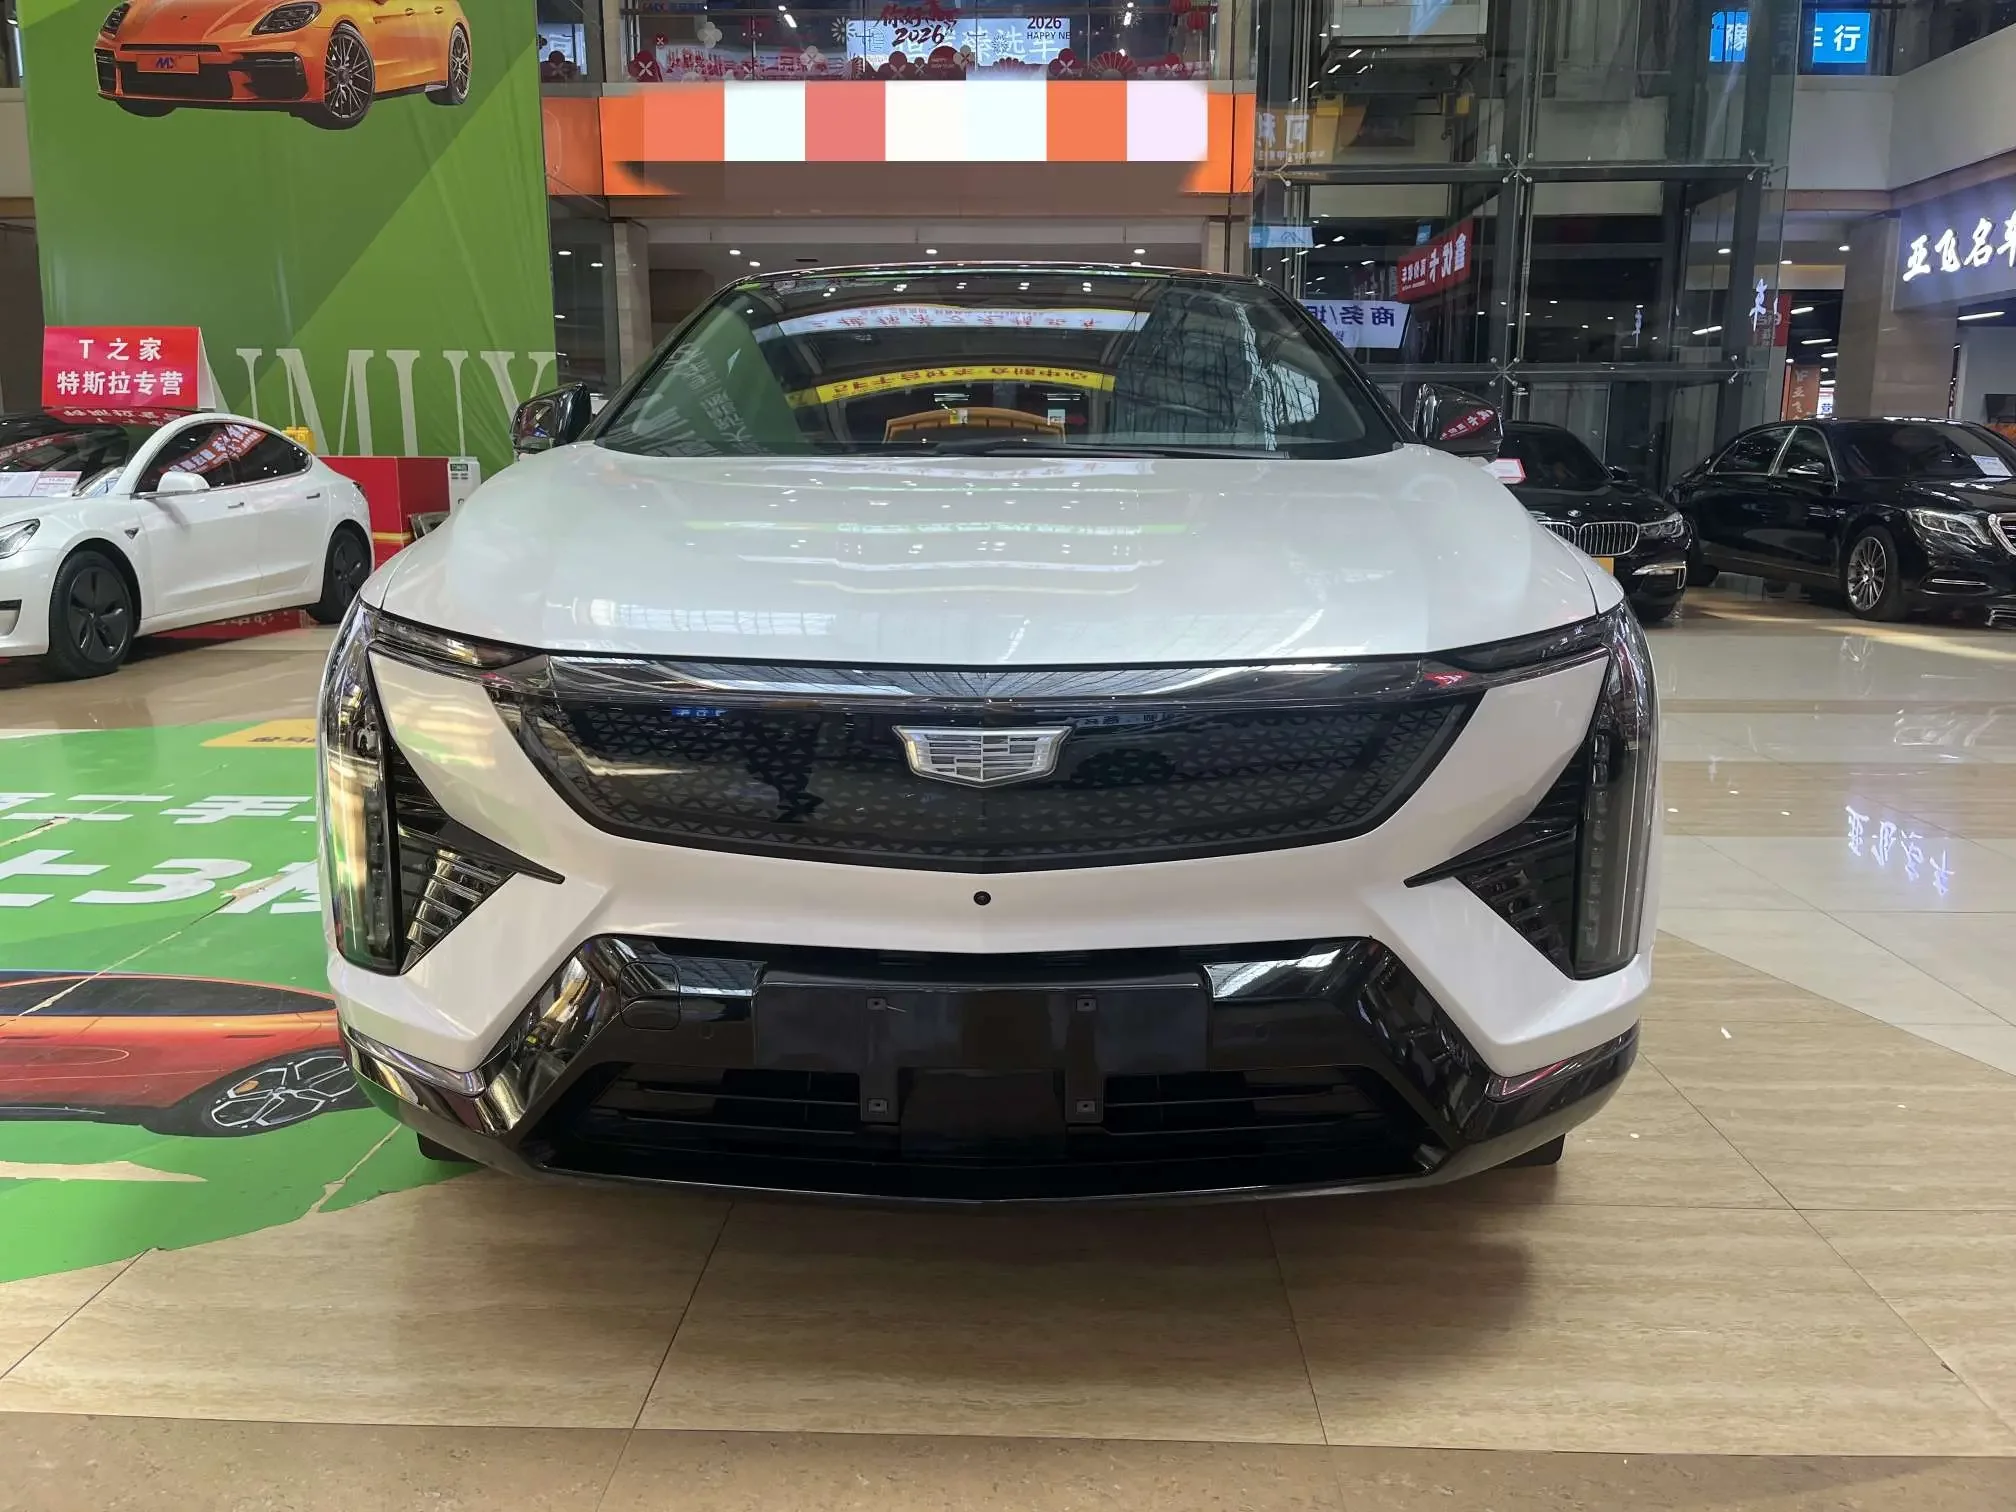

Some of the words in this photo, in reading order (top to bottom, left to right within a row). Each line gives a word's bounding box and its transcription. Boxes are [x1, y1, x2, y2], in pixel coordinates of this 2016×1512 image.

[1027, 16, 1062, 29] 2026
[892, 25, 945, 46] 2026
[1027, 32, 1055, 40] HAPPY
[57, 371, 183, 396] 特斯拉专营
